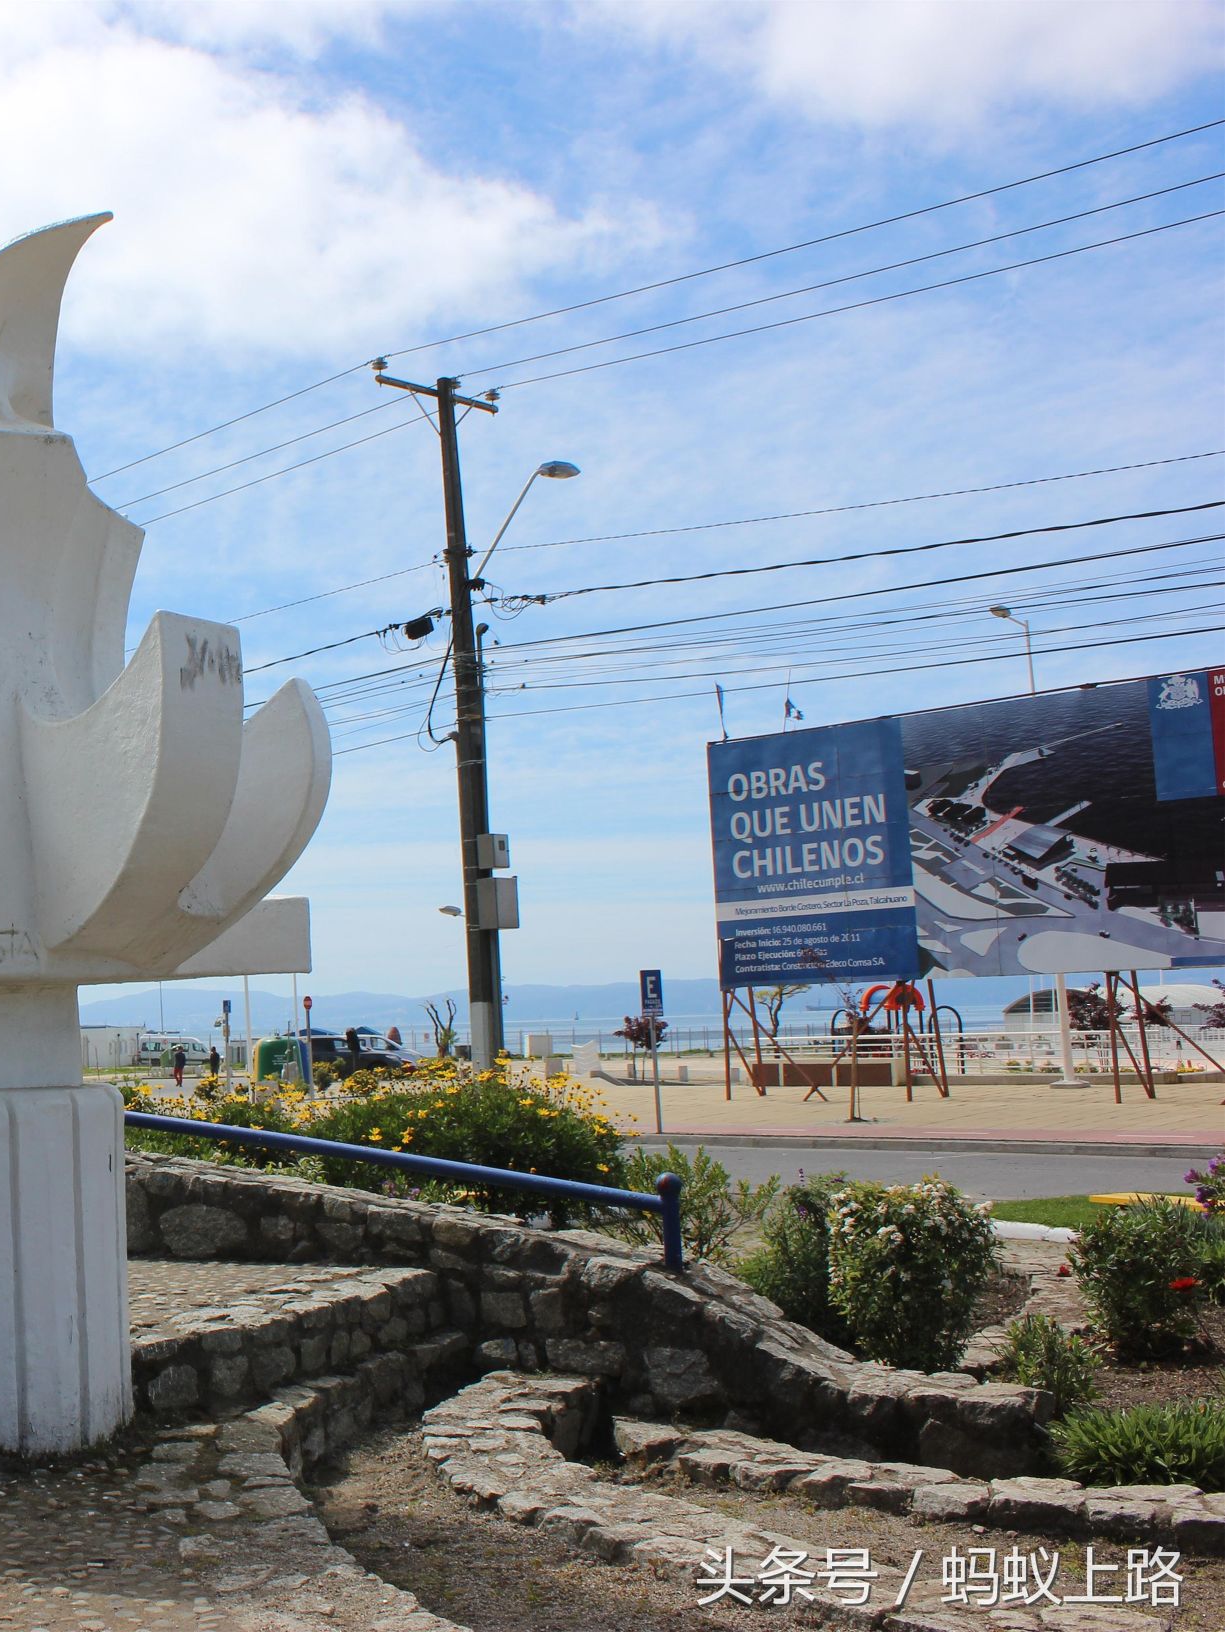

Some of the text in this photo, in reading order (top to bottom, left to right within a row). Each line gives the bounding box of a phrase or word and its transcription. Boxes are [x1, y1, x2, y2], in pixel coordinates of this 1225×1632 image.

[727, 761, 826, 802] OBRAS
[730, 793, 887, 844] QUE UNEN
[732, 835, 885, 879] CHILENOS
[757, 873, 865, 893] www.chilecumple.cl
[735, 906, 778, 916] Mejoramiento
[779, 904, 796, 912] Borde
[823, 900, 843, 909] Sector
[870, 896, 908, 905] Talcahuano
[734, 941, 757, 949] Fecha
[782, 937, 792, 945] 25
[793, 936, 803, 945] de
[804, 935, 828, 946] agosto
[829, 934, 840, 943] de
[734, 953, 756, 961] Plazo
[646, 976, 657, 998] E
